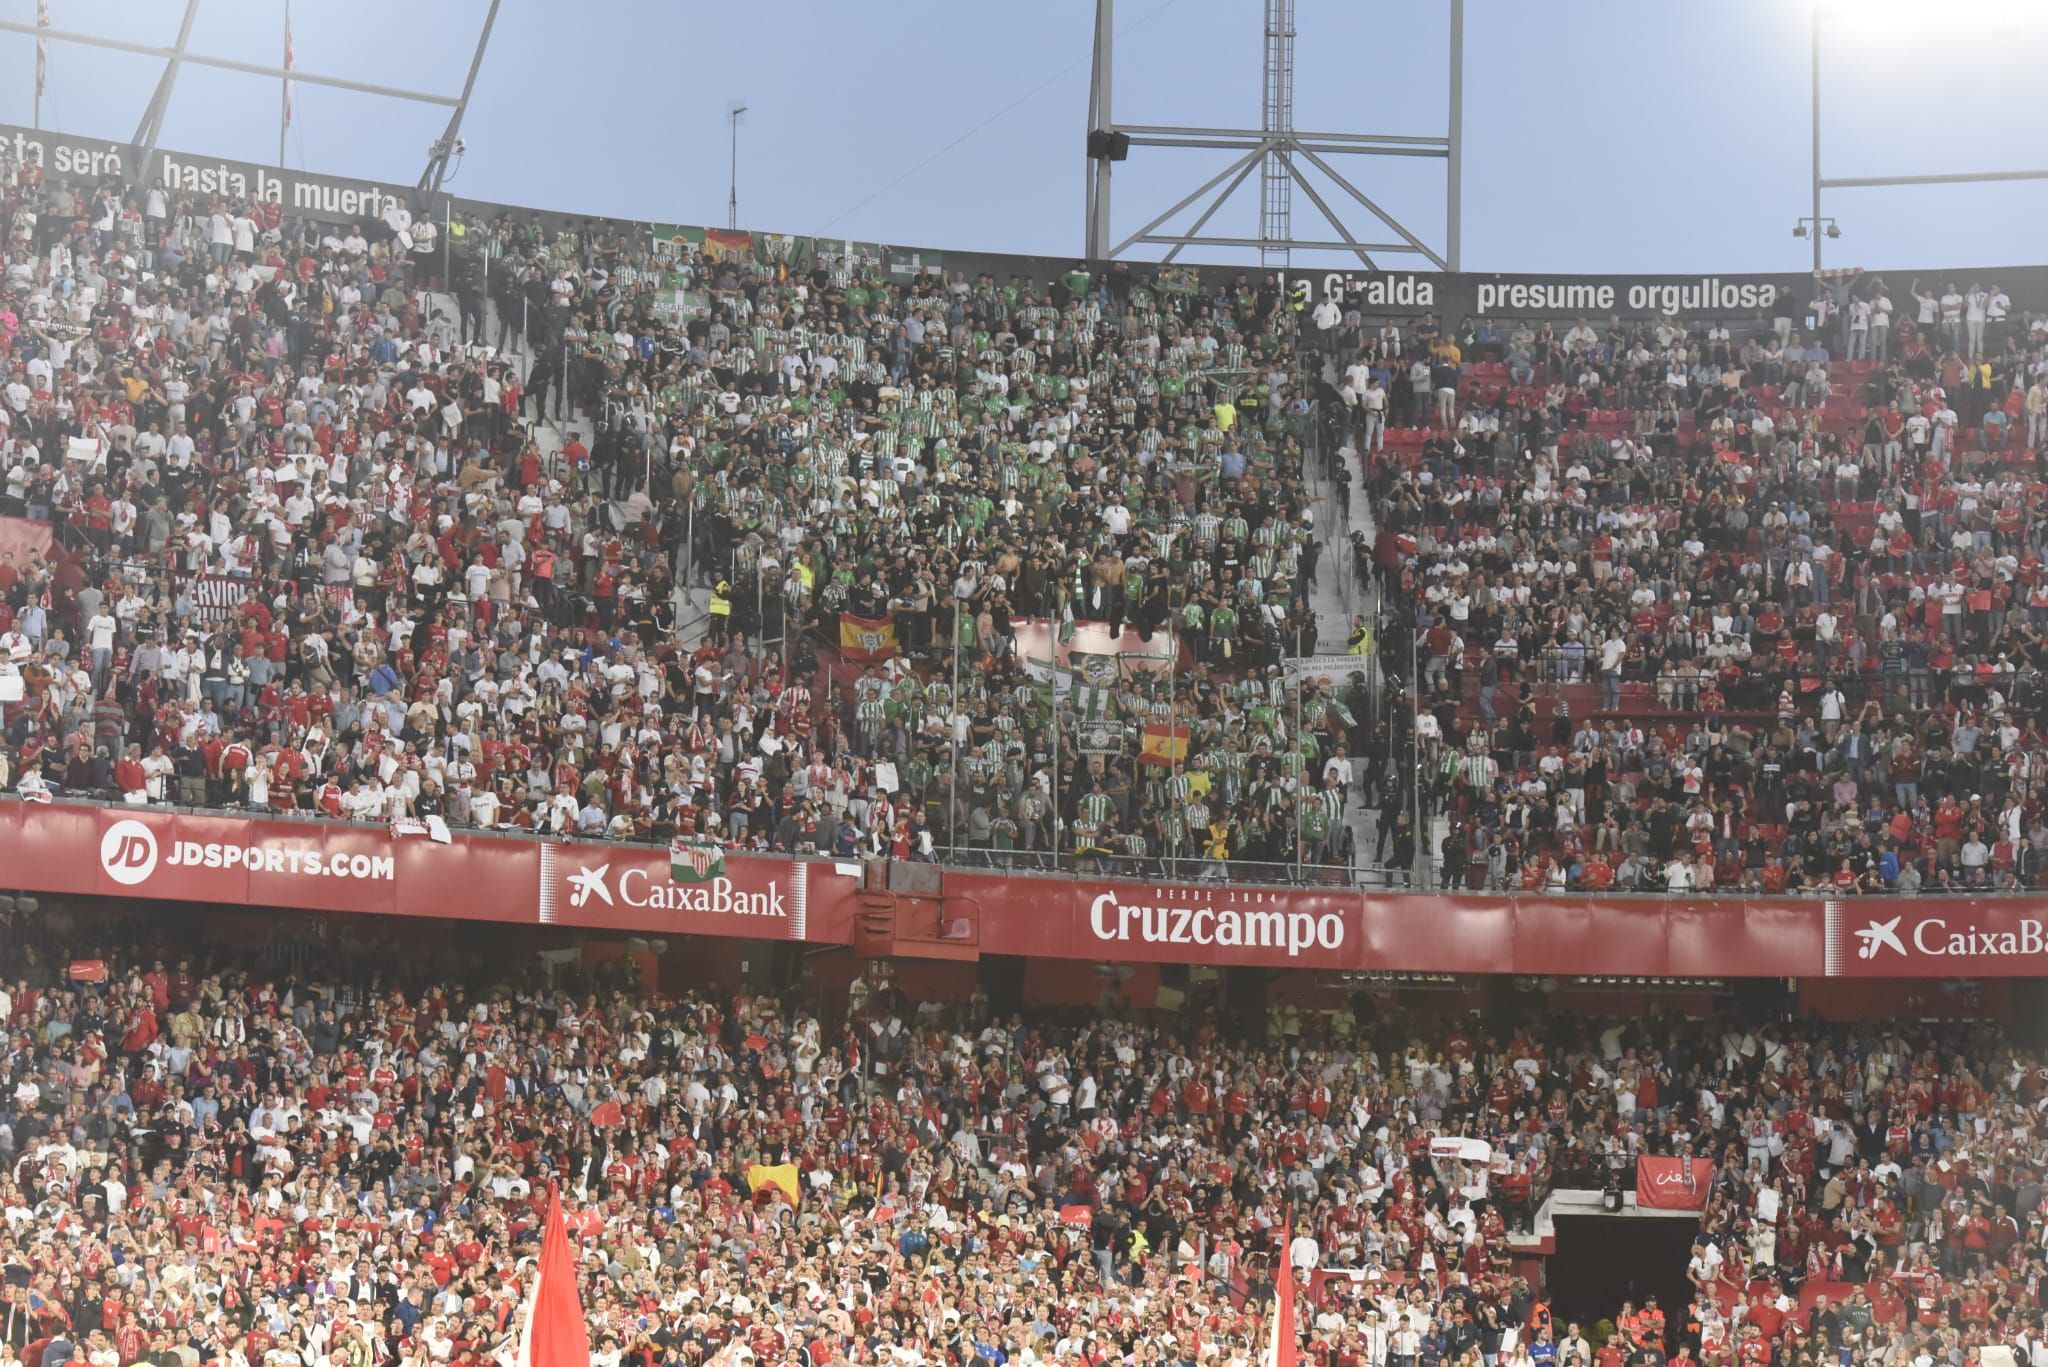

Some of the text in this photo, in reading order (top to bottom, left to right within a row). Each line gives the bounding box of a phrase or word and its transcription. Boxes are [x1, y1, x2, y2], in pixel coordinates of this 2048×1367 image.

[164, 155, 246, 198] hasta
[258, 169, 282, 203] la
[1477, 278, 1776, 315] presume orgullosa
[109, 836, 150, 868] JD
[166, 841, 394, 880] JDSPORTS.COM
[619, 868, 787, 917] CaixaBank
[1156, 888, 1276, 903] DESDE 1904
[1090, 890, 1344, 956] Cruzcampo
[1913, 918, 2048, 955] CaixaB
